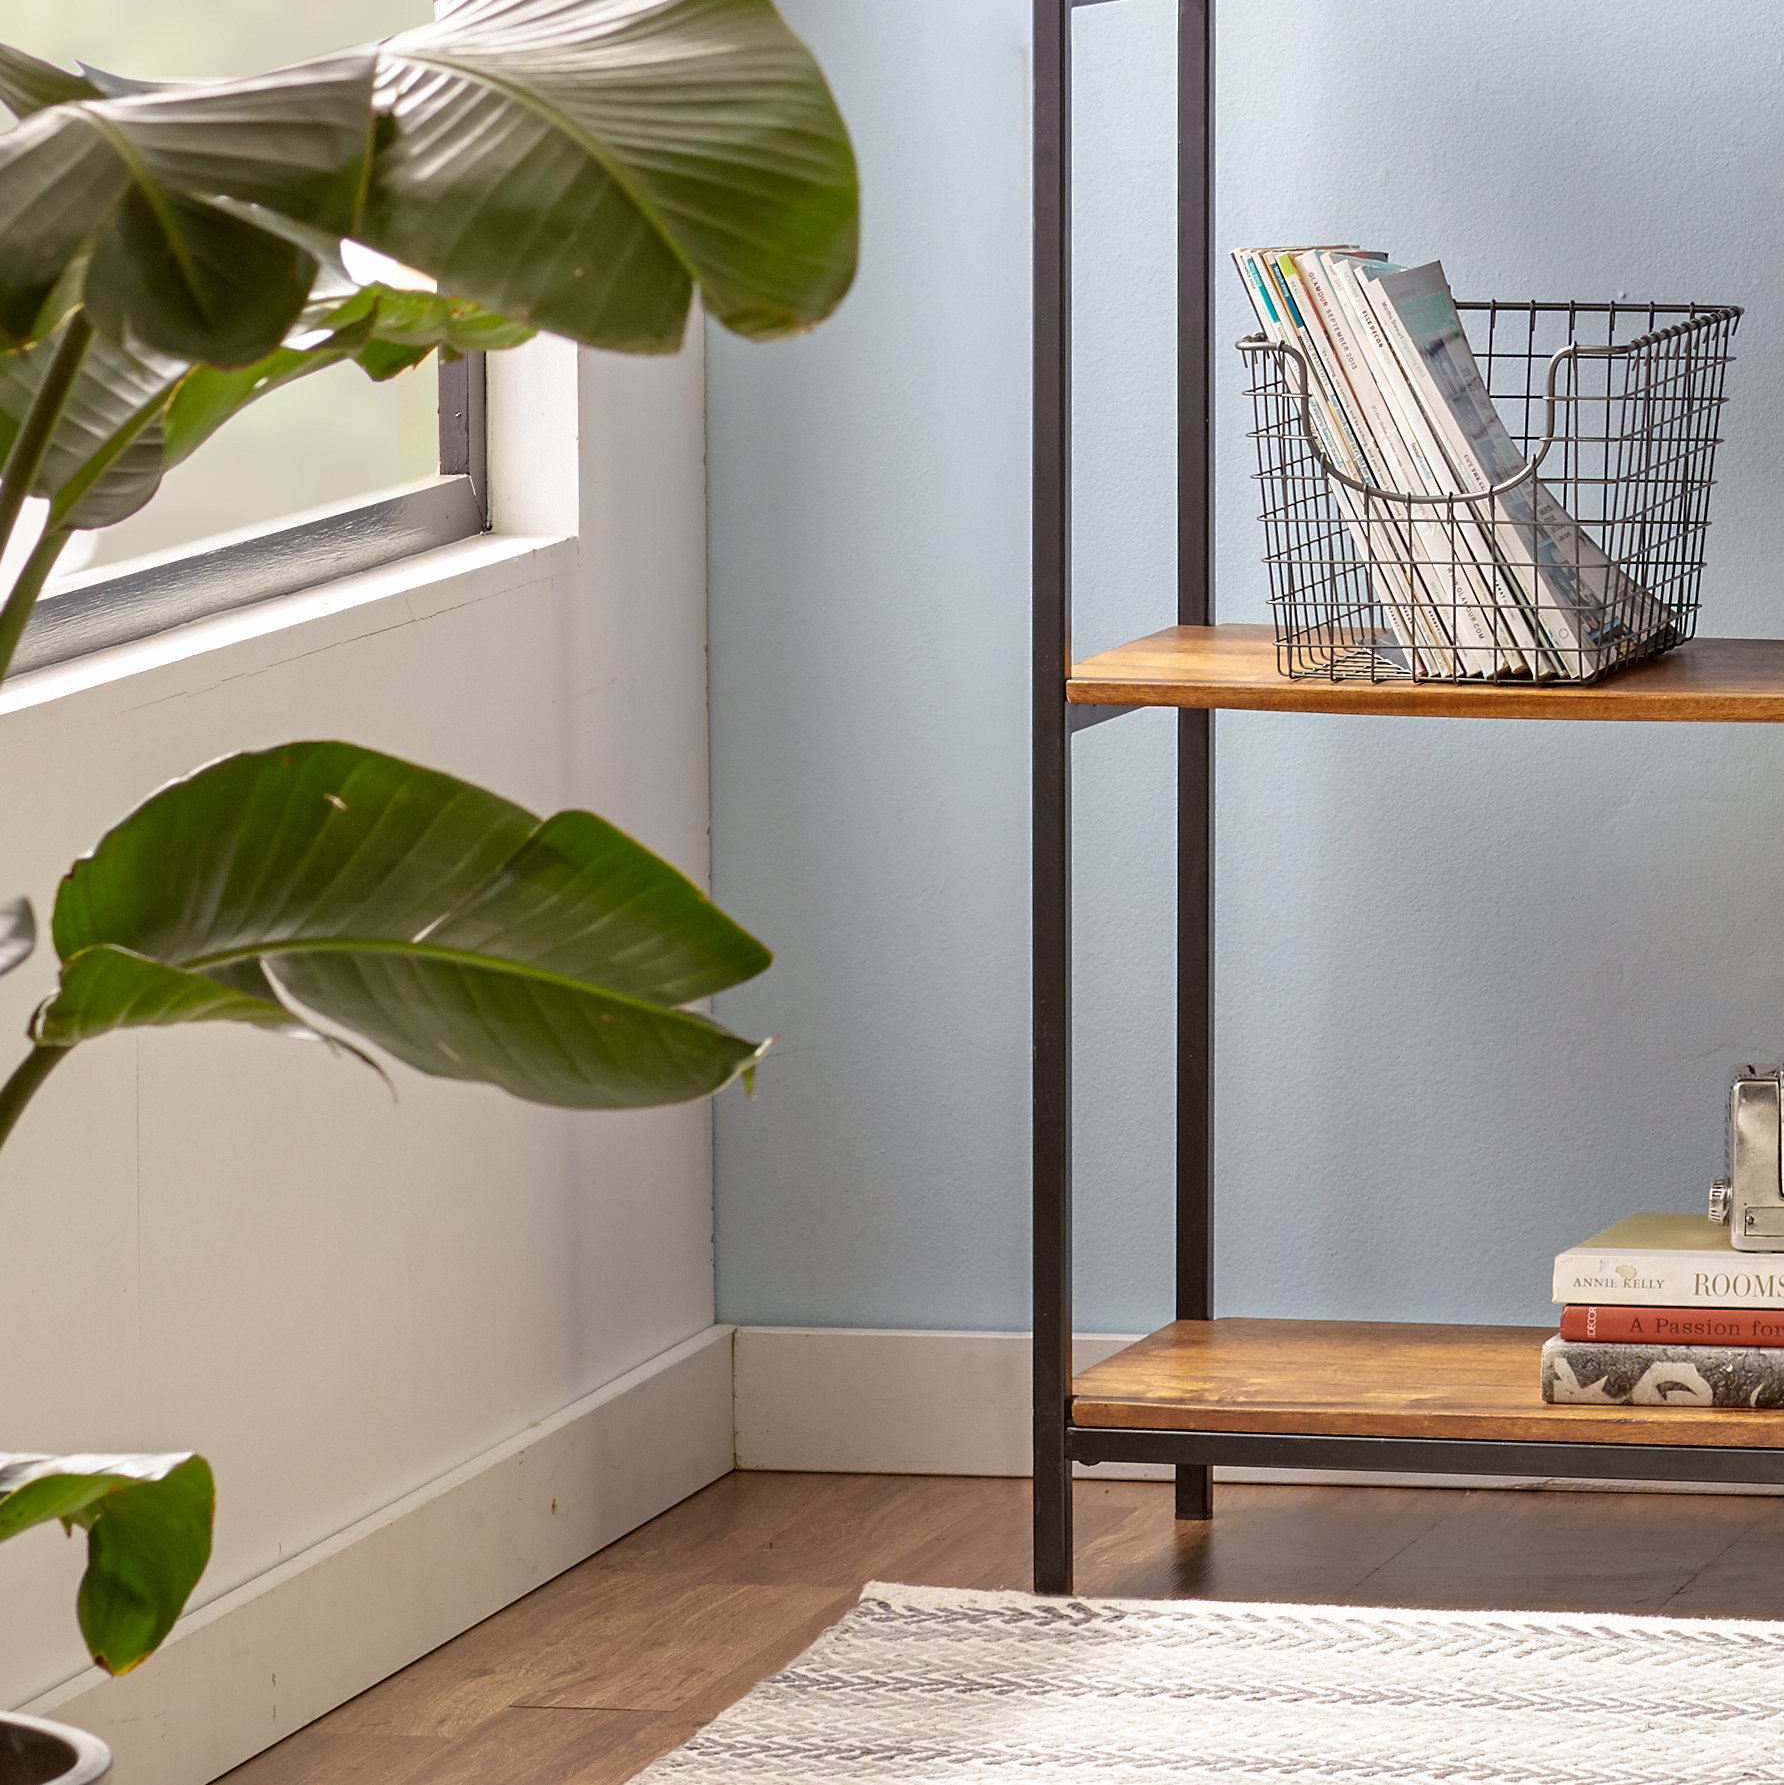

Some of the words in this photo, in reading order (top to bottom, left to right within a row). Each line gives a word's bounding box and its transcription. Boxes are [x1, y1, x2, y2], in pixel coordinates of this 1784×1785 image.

[1308, 271, 1328, 307] GLAMOUR
[1325, 309, 1348, 351] SEPTEMBER
[1345, 352, 1357, 370] 2013
[1362, 309, 1372, 324] ELLE
[1369, 325, 1383, 348] DECOR
[1381, 301, 1394, 320] Martha
[1390, 319, 1404, 339] Stewart
[1463, 453, 1473, 467] CUT
[1471, 468, 1480, 481] THE
[1573, 1277, 1618, 1289] ANNIE
[1623, 1278, 1665, 1290] KELLY
[1628, 1317, 1645, 1334] A
[1654, 1317, 1741, 1337] Passion
[1751, 1320, 1784, 1338] for
